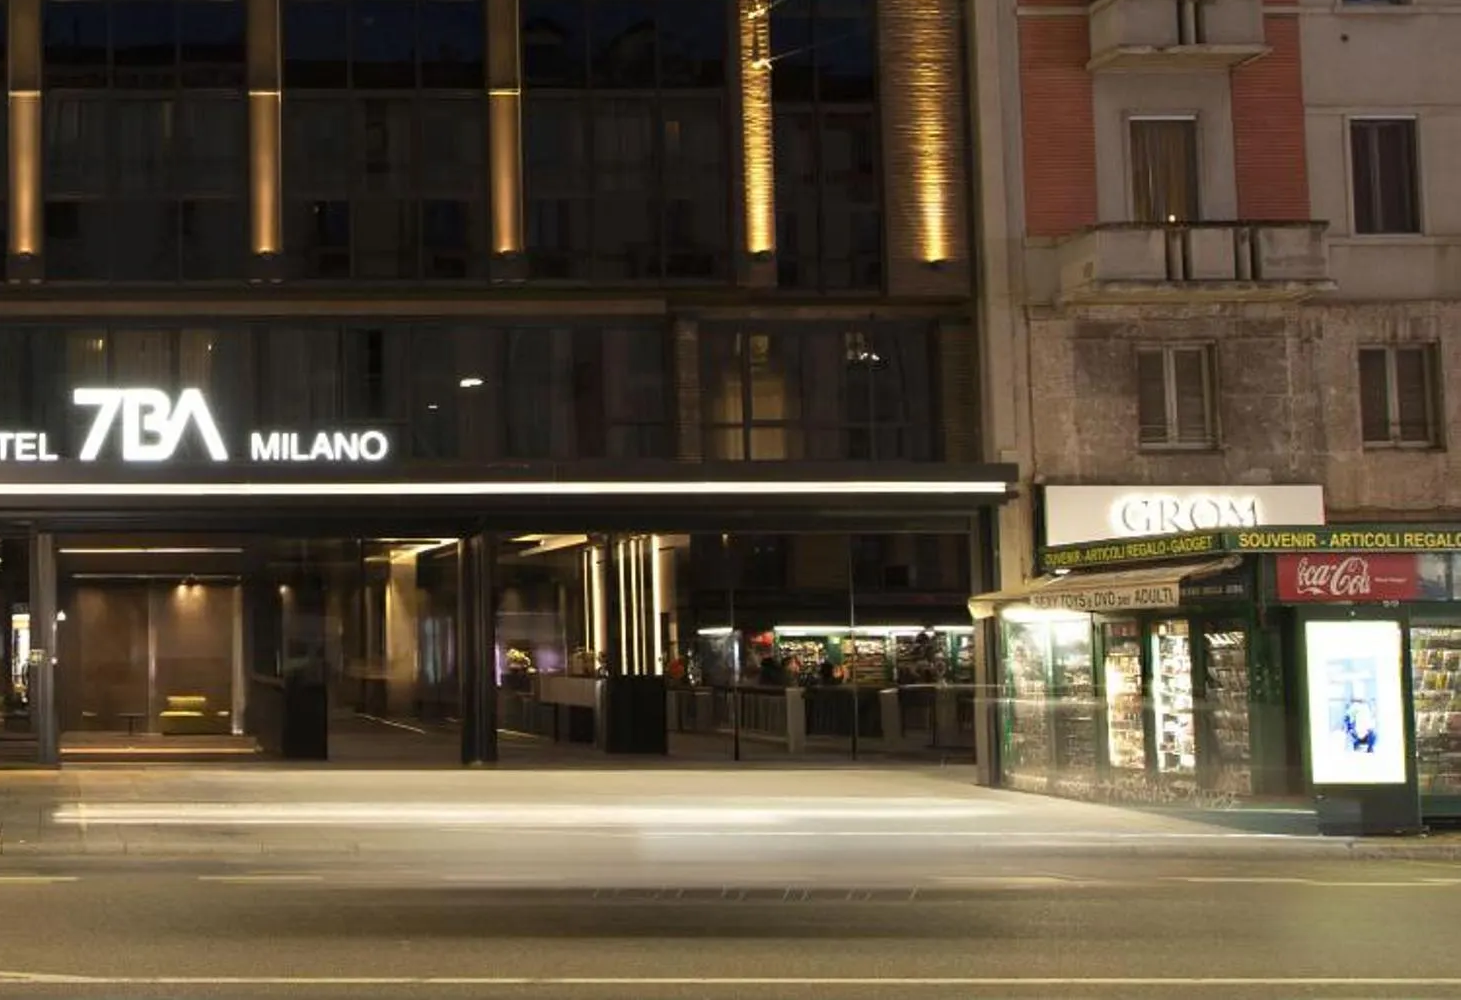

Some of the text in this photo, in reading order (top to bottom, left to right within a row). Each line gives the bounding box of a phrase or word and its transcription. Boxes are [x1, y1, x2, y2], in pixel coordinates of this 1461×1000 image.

[251, 431, 388, 461] MILANO
[1121, 499, 1258, 531] GROM
[1127, 541, 1166, 558] REGALO
[1171, 535, 1212, 553] GADGET
[1239, 532, 1316, 547] SOUVENIR
[1329, 532, 1400, 547] ARTICOLI
[1060, 593, 1086, 609] TOYS
[1094, 591, 1115, 607] DVD
